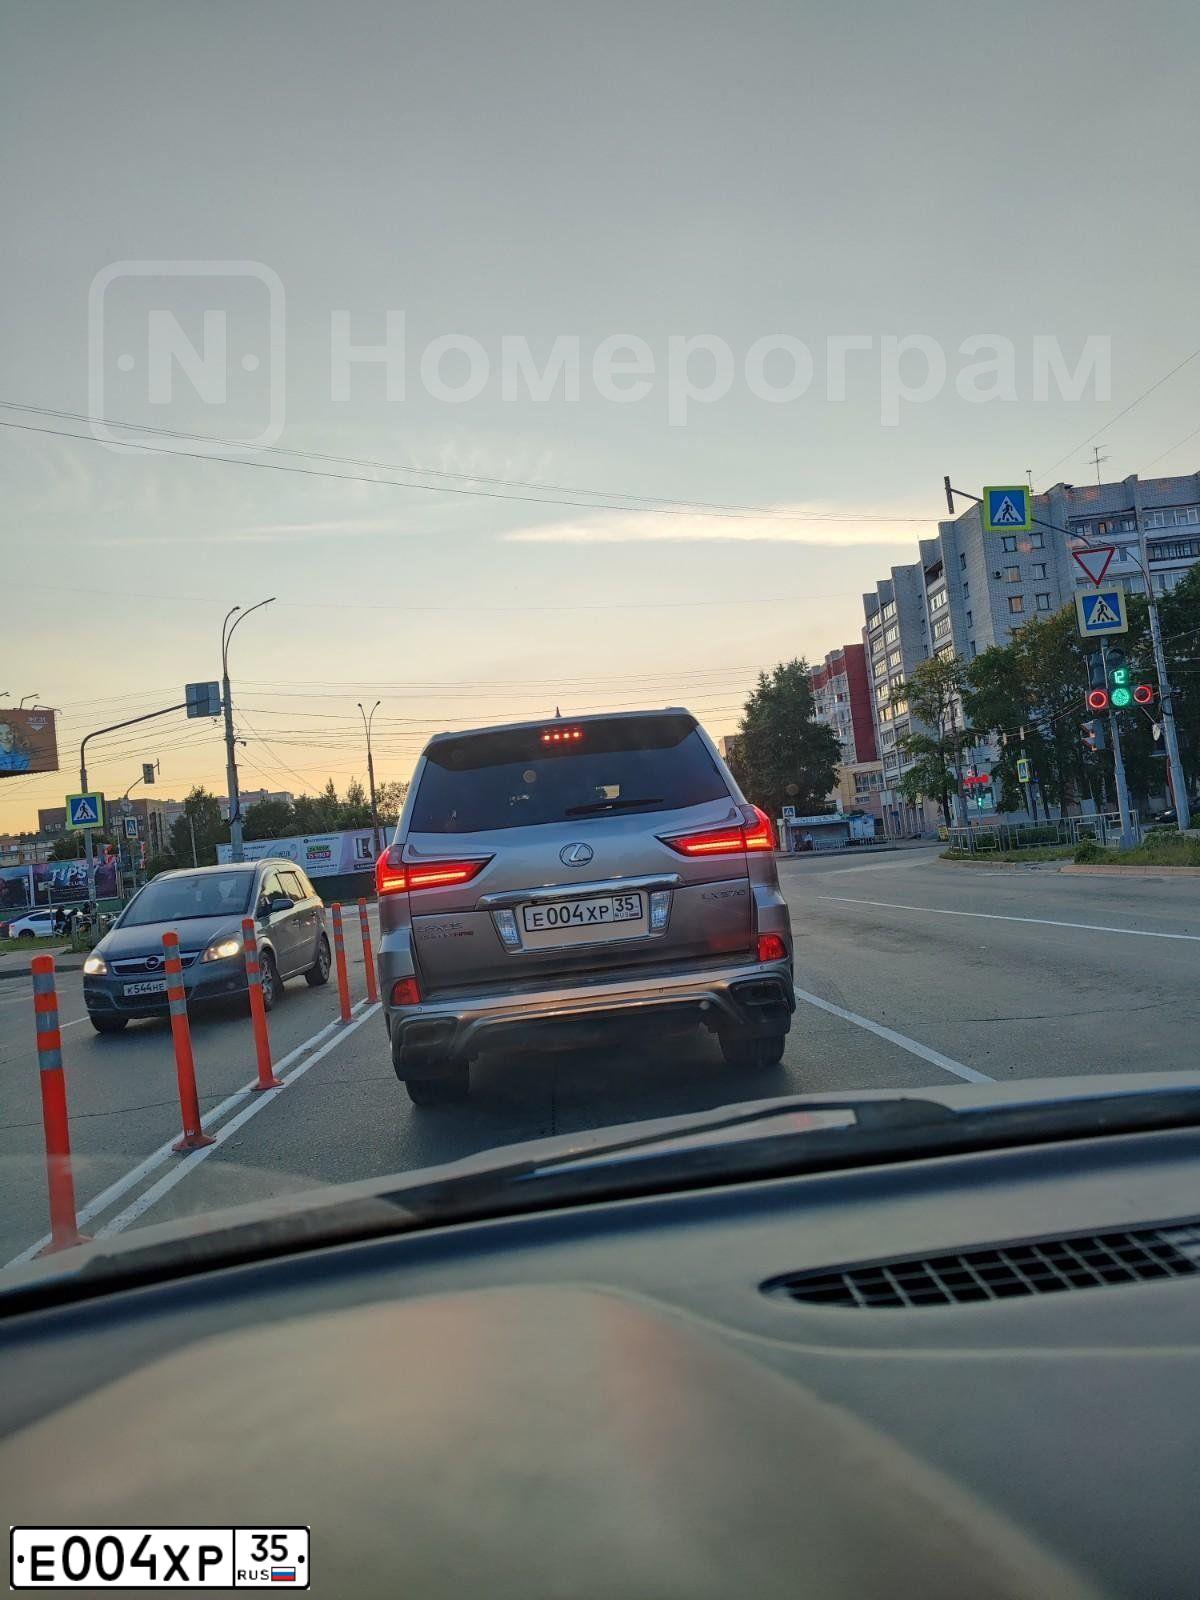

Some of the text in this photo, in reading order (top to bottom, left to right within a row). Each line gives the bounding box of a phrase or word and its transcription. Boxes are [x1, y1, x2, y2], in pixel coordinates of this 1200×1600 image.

[49, 863, 89, 882] TIPS
[533, 896, 634, 927] Е004ХР 35
[127, 983, 165, 994] К544НЕ
